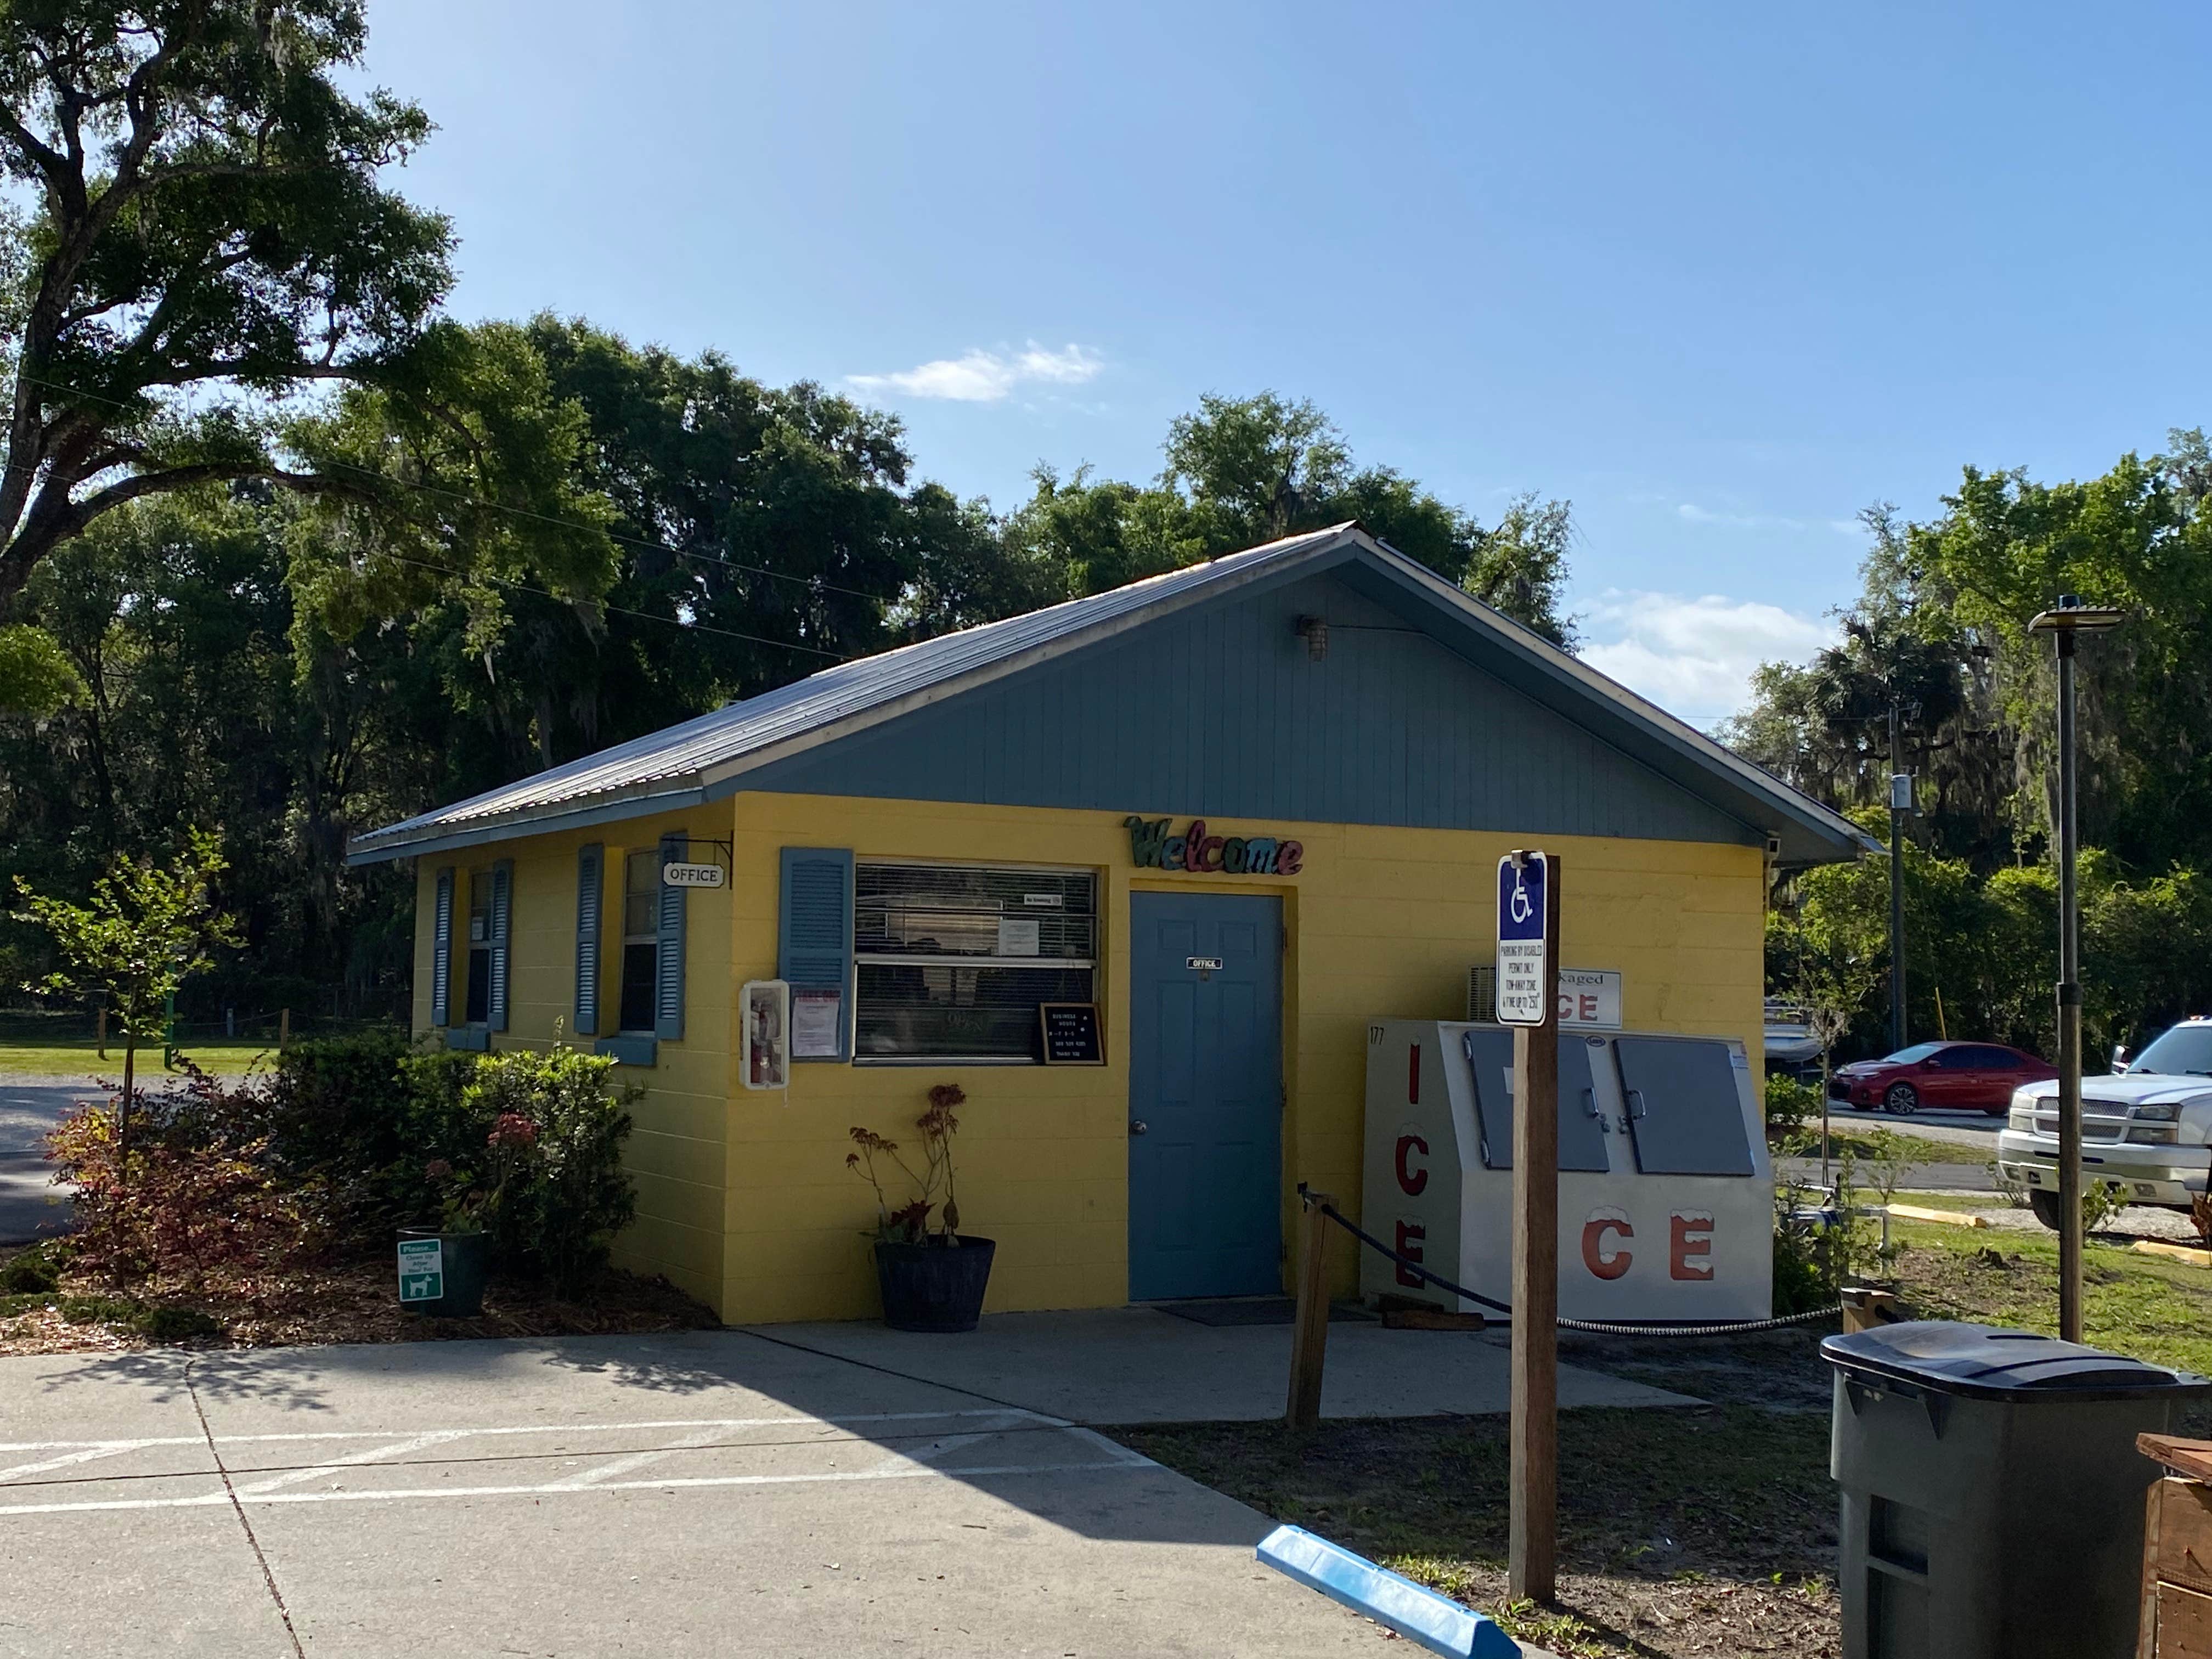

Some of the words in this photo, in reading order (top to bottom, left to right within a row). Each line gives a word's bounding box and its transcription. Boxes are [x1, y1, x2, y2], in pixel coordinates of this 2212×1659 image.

[1122, 816, 1304, 876] Welcome
[670, 868, 718, 882] OFFICE
[1500, 945, 1517, 957] PARKING
[1518, 945, 1523, 957] BY
[1523, 945, 1542, 956] DISABLED
[1509, 963, 1523, 974] PERMIT
[1524, 963, 1534, 974] ONLY
[1506, 979, 1525, 991] TOW-AWAY
[1526, 979, 1536, 991] ZONE
[1558, 972, 1604, 986] kaged
[1516, 996, 1522, 1008] UP
[1558, 994, 1598, 1022] CE
[1370, 1026, 1384, 1045] 177
[1395, 1036, 1429, 1290] ICE
[1582, 1205, 1715, 1280] CE
